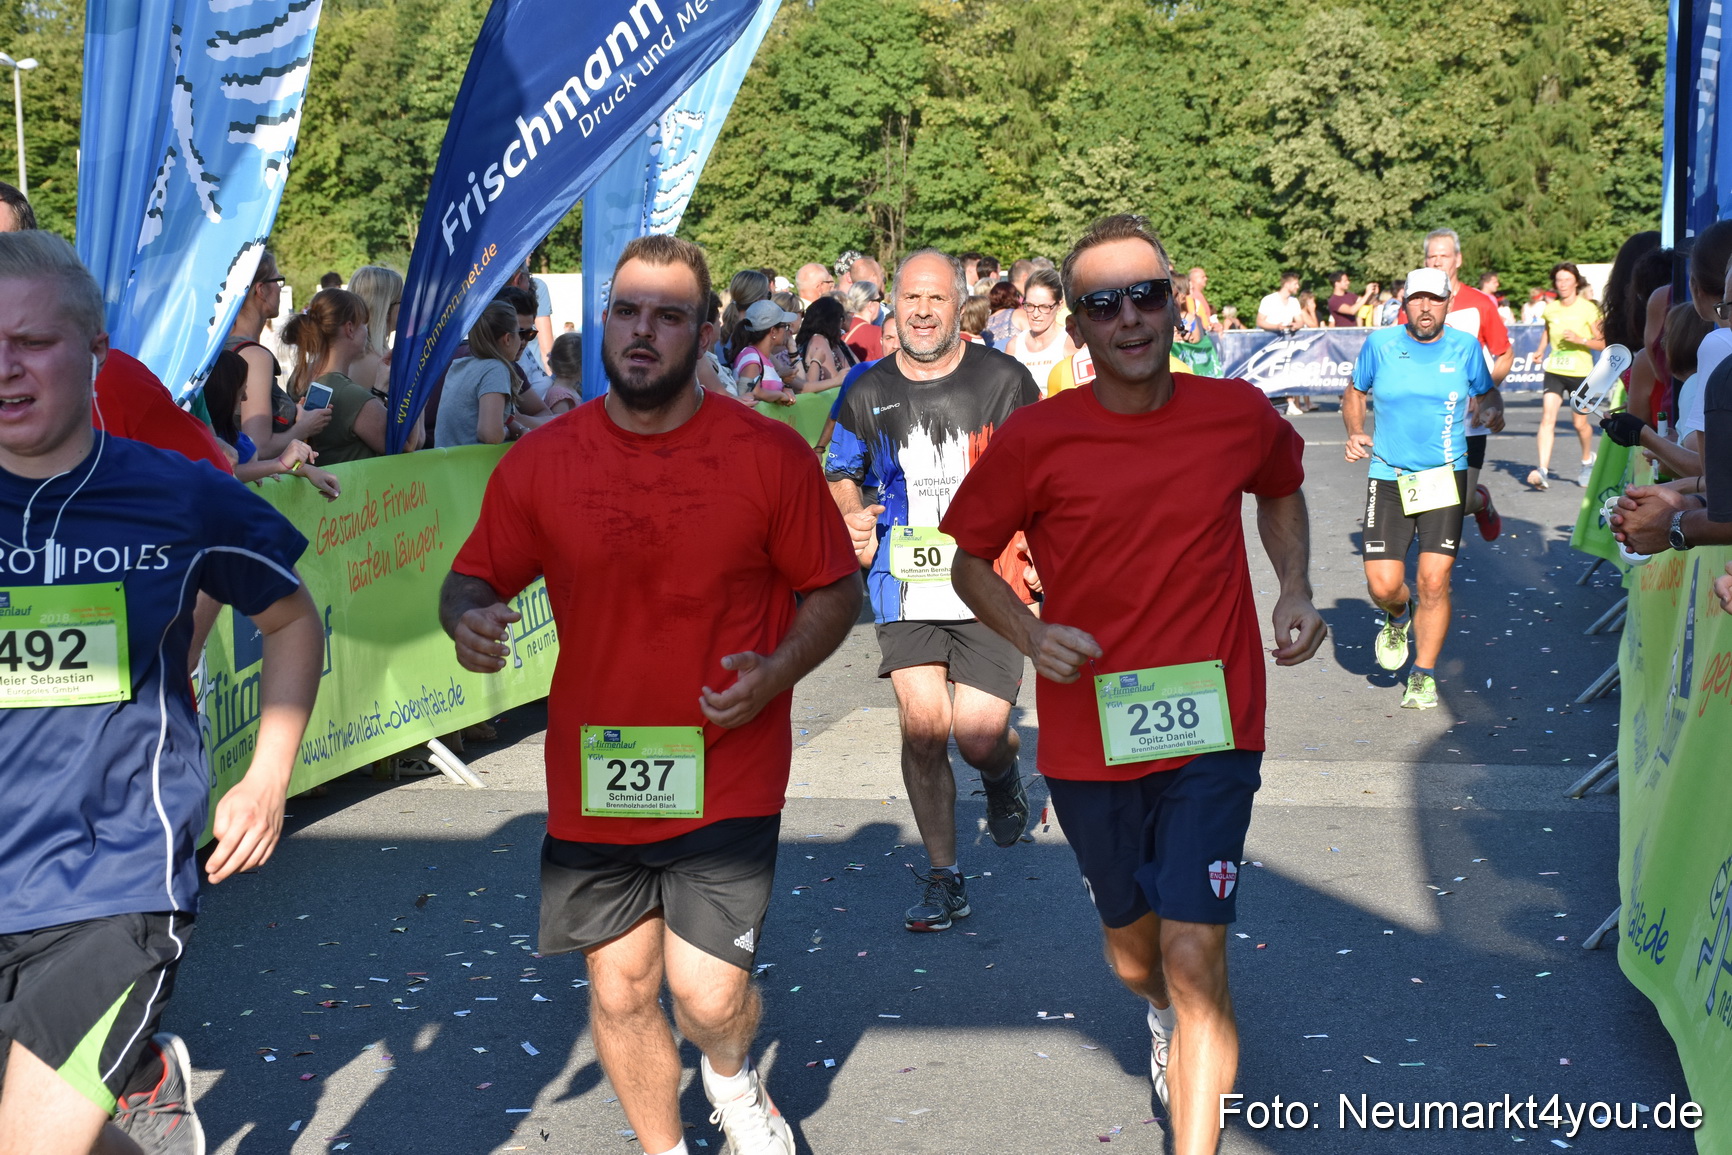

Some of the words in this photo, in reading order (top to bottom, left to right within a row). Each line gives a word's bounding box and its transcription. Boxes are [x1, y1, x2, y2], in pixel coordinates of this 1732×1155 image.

[578, 72, 637, 138] Druck
[637, 24, 676, 76] und
[676, 0, 714, 33] Me
[441, 0, 664, 256] Frischmann
[1268, 357, 1358, 377] Fische
[913, 476, 957, 487] AUTOHAUS
[918, 487, 950, 497] MÜLLER
[315, 489, 380, 557] Gesunde
[382, 479, 428, 526] Firmen
[0, 548, 35, 574] O
[74, 544, 172, 574] POLES
[347, 551, 392, 595] laufen
[395, 508, 444, 572] länger!
[913, 546, 941, 567] 50
[40, 613, 70, 624] 2018
[0, 628, 88, 672] 492
[526, 629, 557, 658] neuma
[31, 673, 94, 685] Sebastian
[52, 686, 80, 694] GmbH
[1113, 682, 1155, 696] firmenlauf
[1127, 697, 1200, 736] 238
[596, 740, 637, 749] firmenlauf
[1131, 741, 1185, 754] Brennholzhandel
[1187, 738, 1206, 747] Blank
[1138, 735, 1164, 746] Opitz
[1166, 731, 1196, 742] Daniel
[219, 722, 260, 774] neumar
[606, 759, 675, 791] 237
[606, 801, 658, 809] Brennholzhandel
[608, 792, 643, 802] Schmid
[645, 793, 675, 802] Daniel
[1210, 872, 1235, 880] ENGLAND
